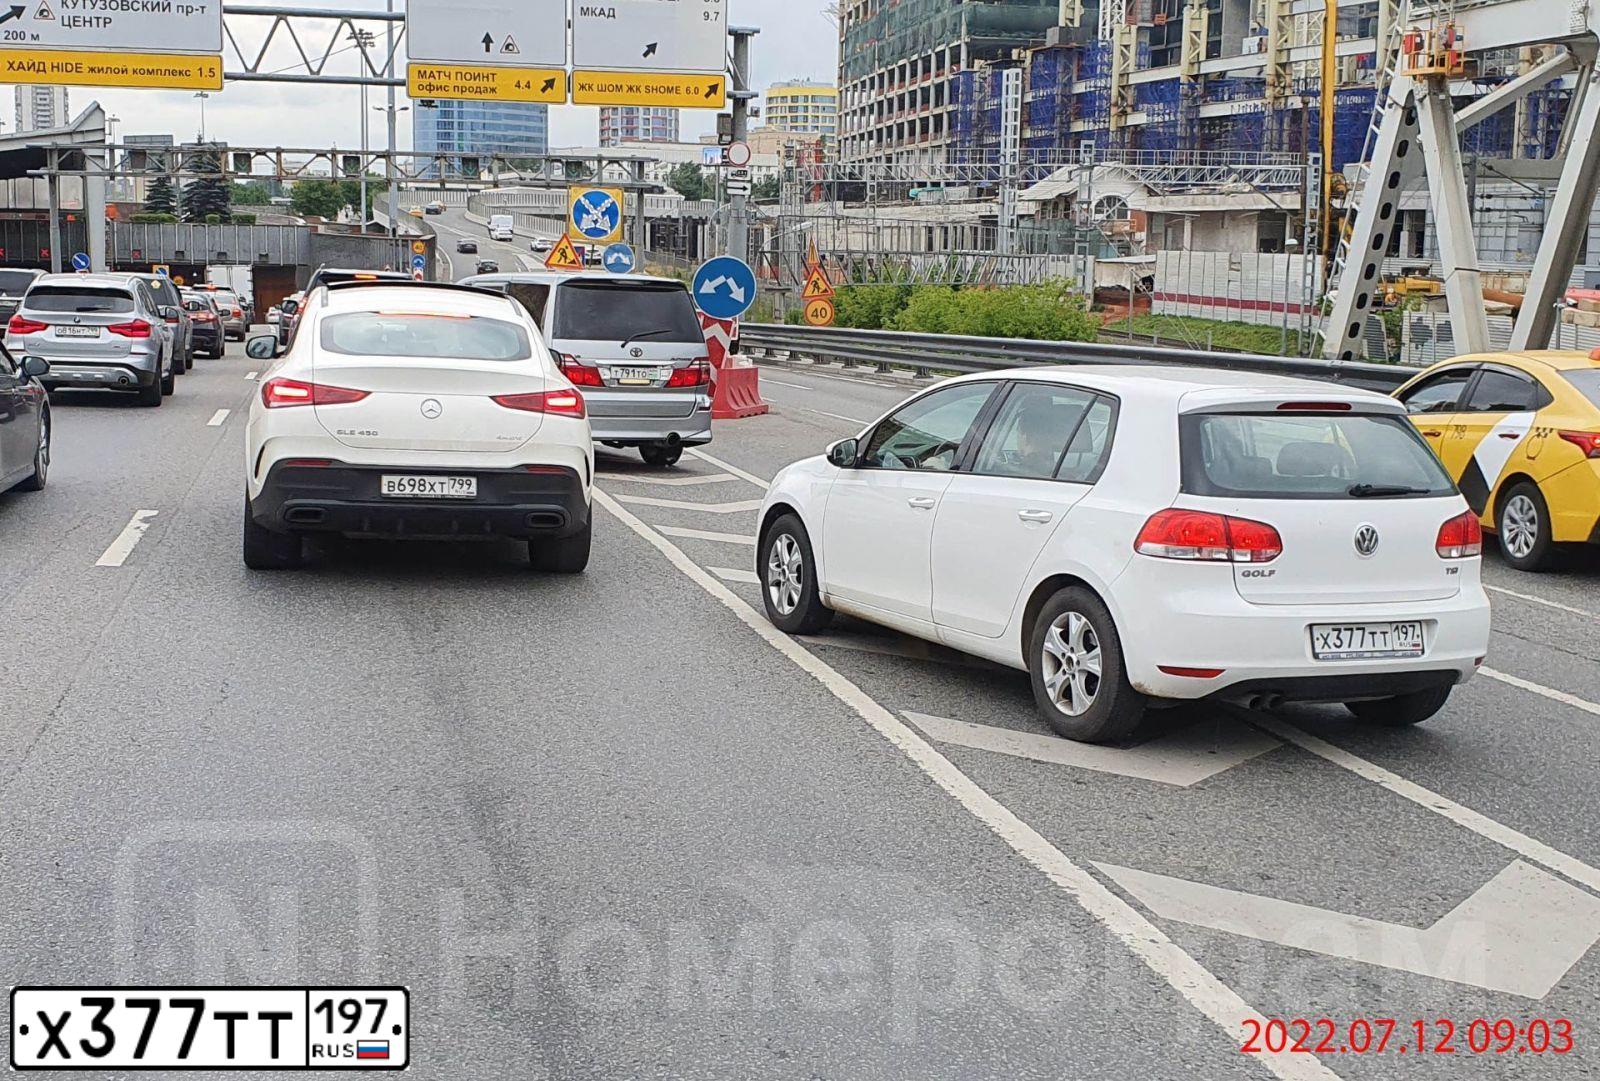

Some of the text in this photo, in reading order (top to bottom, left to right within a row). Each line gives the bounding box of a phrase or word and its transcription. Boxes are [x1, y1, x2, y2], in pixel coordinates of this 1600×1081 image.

[61, 0, 207, 16] КУТУЗОВСКИЙ пр-т
[580, 6, 616, 19] МКАД
[61, 15, 112, 29] ЦЕНТР
[703, 11, 720, 21] 9.7
[4, 30, 26, 41] 200
[7, 59, 216, 78] ХАЙД HIDE жилой комплекс 1.5
[417, 70, 451, 81] МАТЧ
[417, 82, 498, 95] офис продаж
[514, 80, 531, 90] 4.4
[578, 82, 700, 95] ЖК ШОМ ЖК SHOME 6.0
[811, 307, 828, 319] 40
[449, 477, 473, 491] 799
[1241, 569, 1277, 578] GOLF
[1393, 624, 1417, 641] 197
